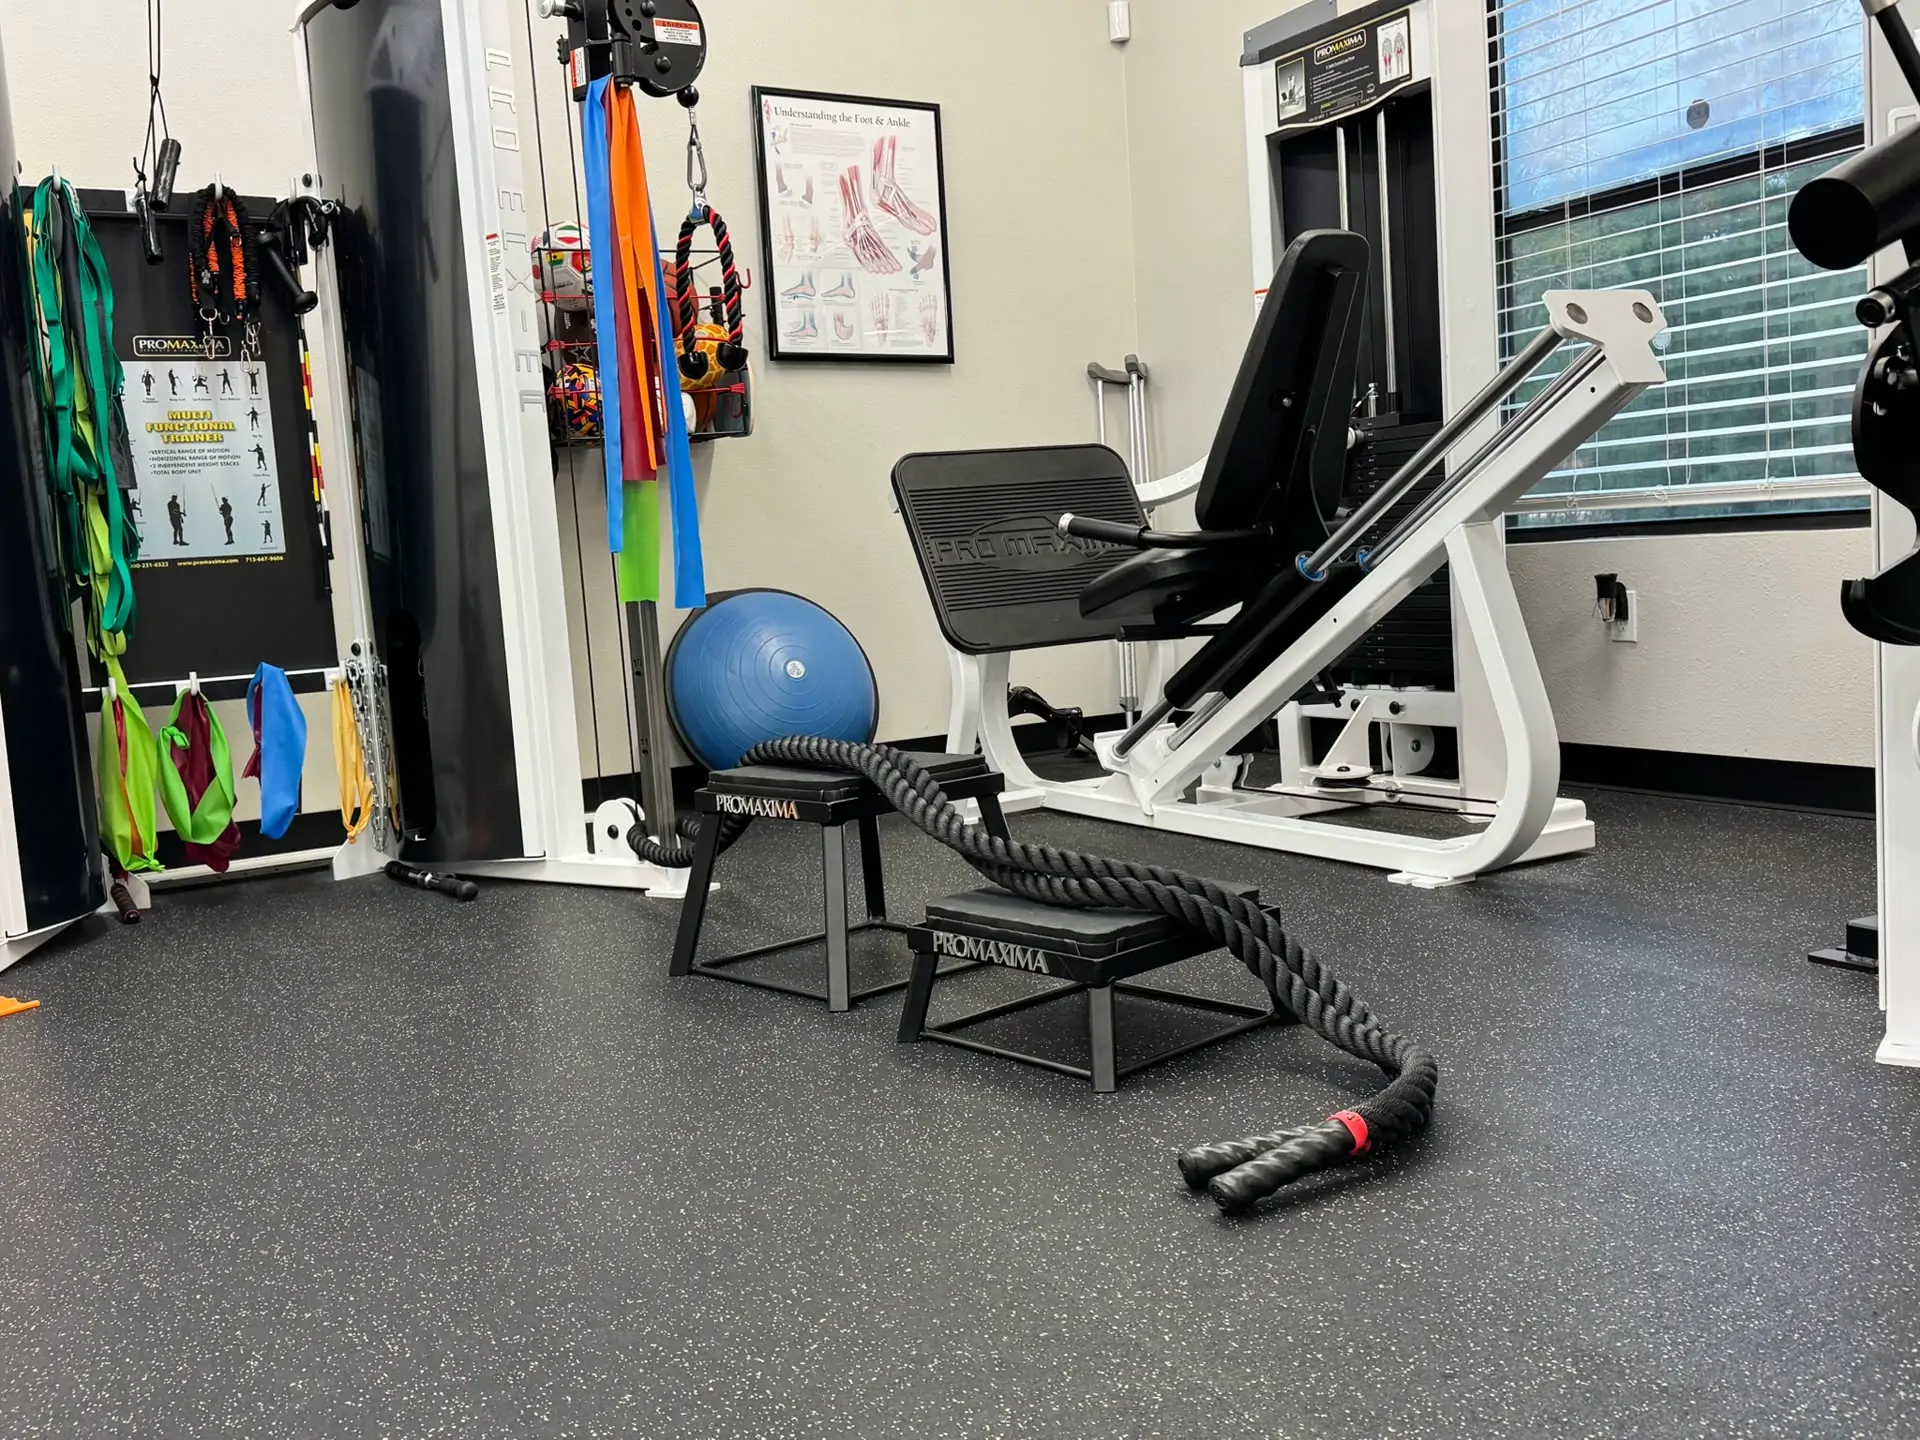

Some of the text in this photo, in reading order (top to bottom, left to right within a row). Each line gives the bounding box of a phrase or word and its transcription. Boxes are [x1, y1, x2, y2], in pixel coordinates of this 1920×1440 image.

[1316, 34, 1363, 58] PROMAXIMA
[774, 106, 911, 128] Understanding the Foot & Ankle
[168, 410, 212, 420] MULTI
[145, 422, 236, 433] FUNCTIONAL
[161, 433, 224, 444] TRAINER
[716, 795, 799, 820] PROMAXIMA
[933, 931, 1050, 974] PROMAXIMA
